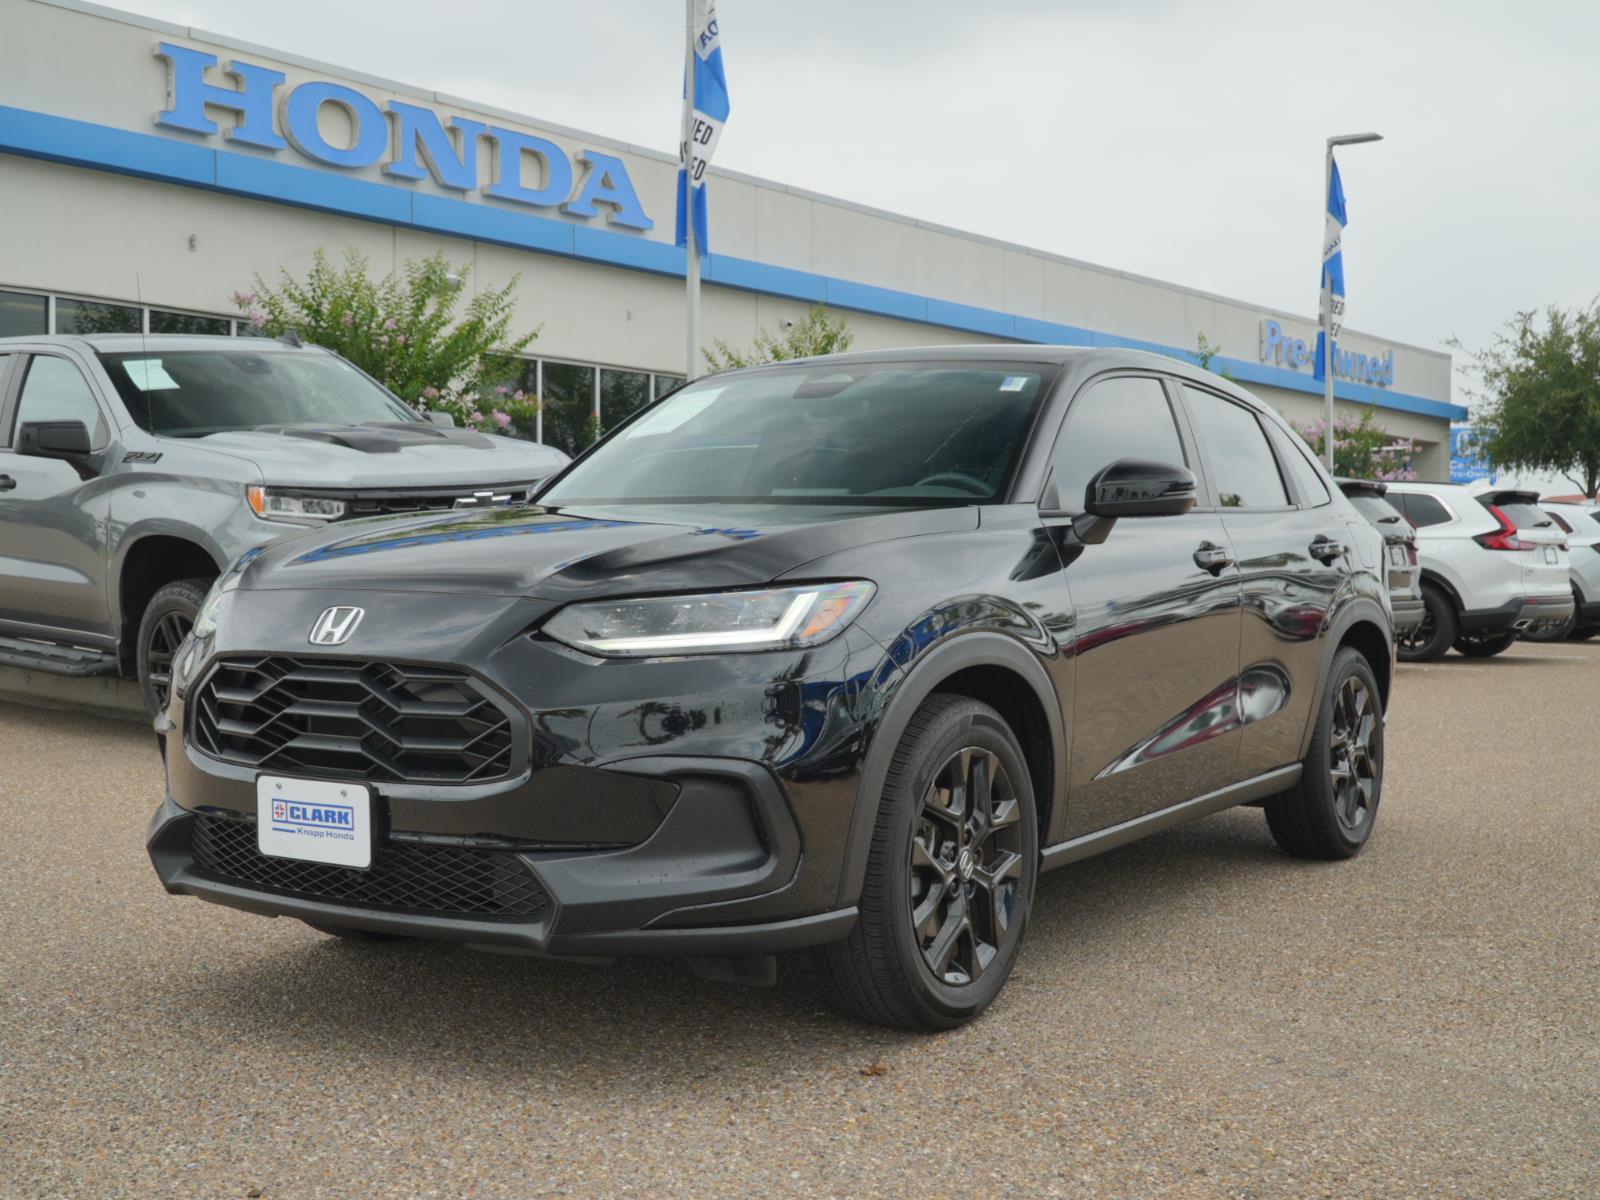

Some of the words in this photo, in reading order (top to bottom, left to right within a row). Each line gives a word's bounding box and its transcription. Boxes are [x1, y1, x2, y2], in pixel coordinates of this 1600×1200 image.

[154, 41, 654, 231] HONDA
[1261, 319, 1393, 386] Pre-wned
[290, 806, 350, 825] CLARK
[296, 827, 325, 839] Knapp
[326, 830, 355, 841] Honda
